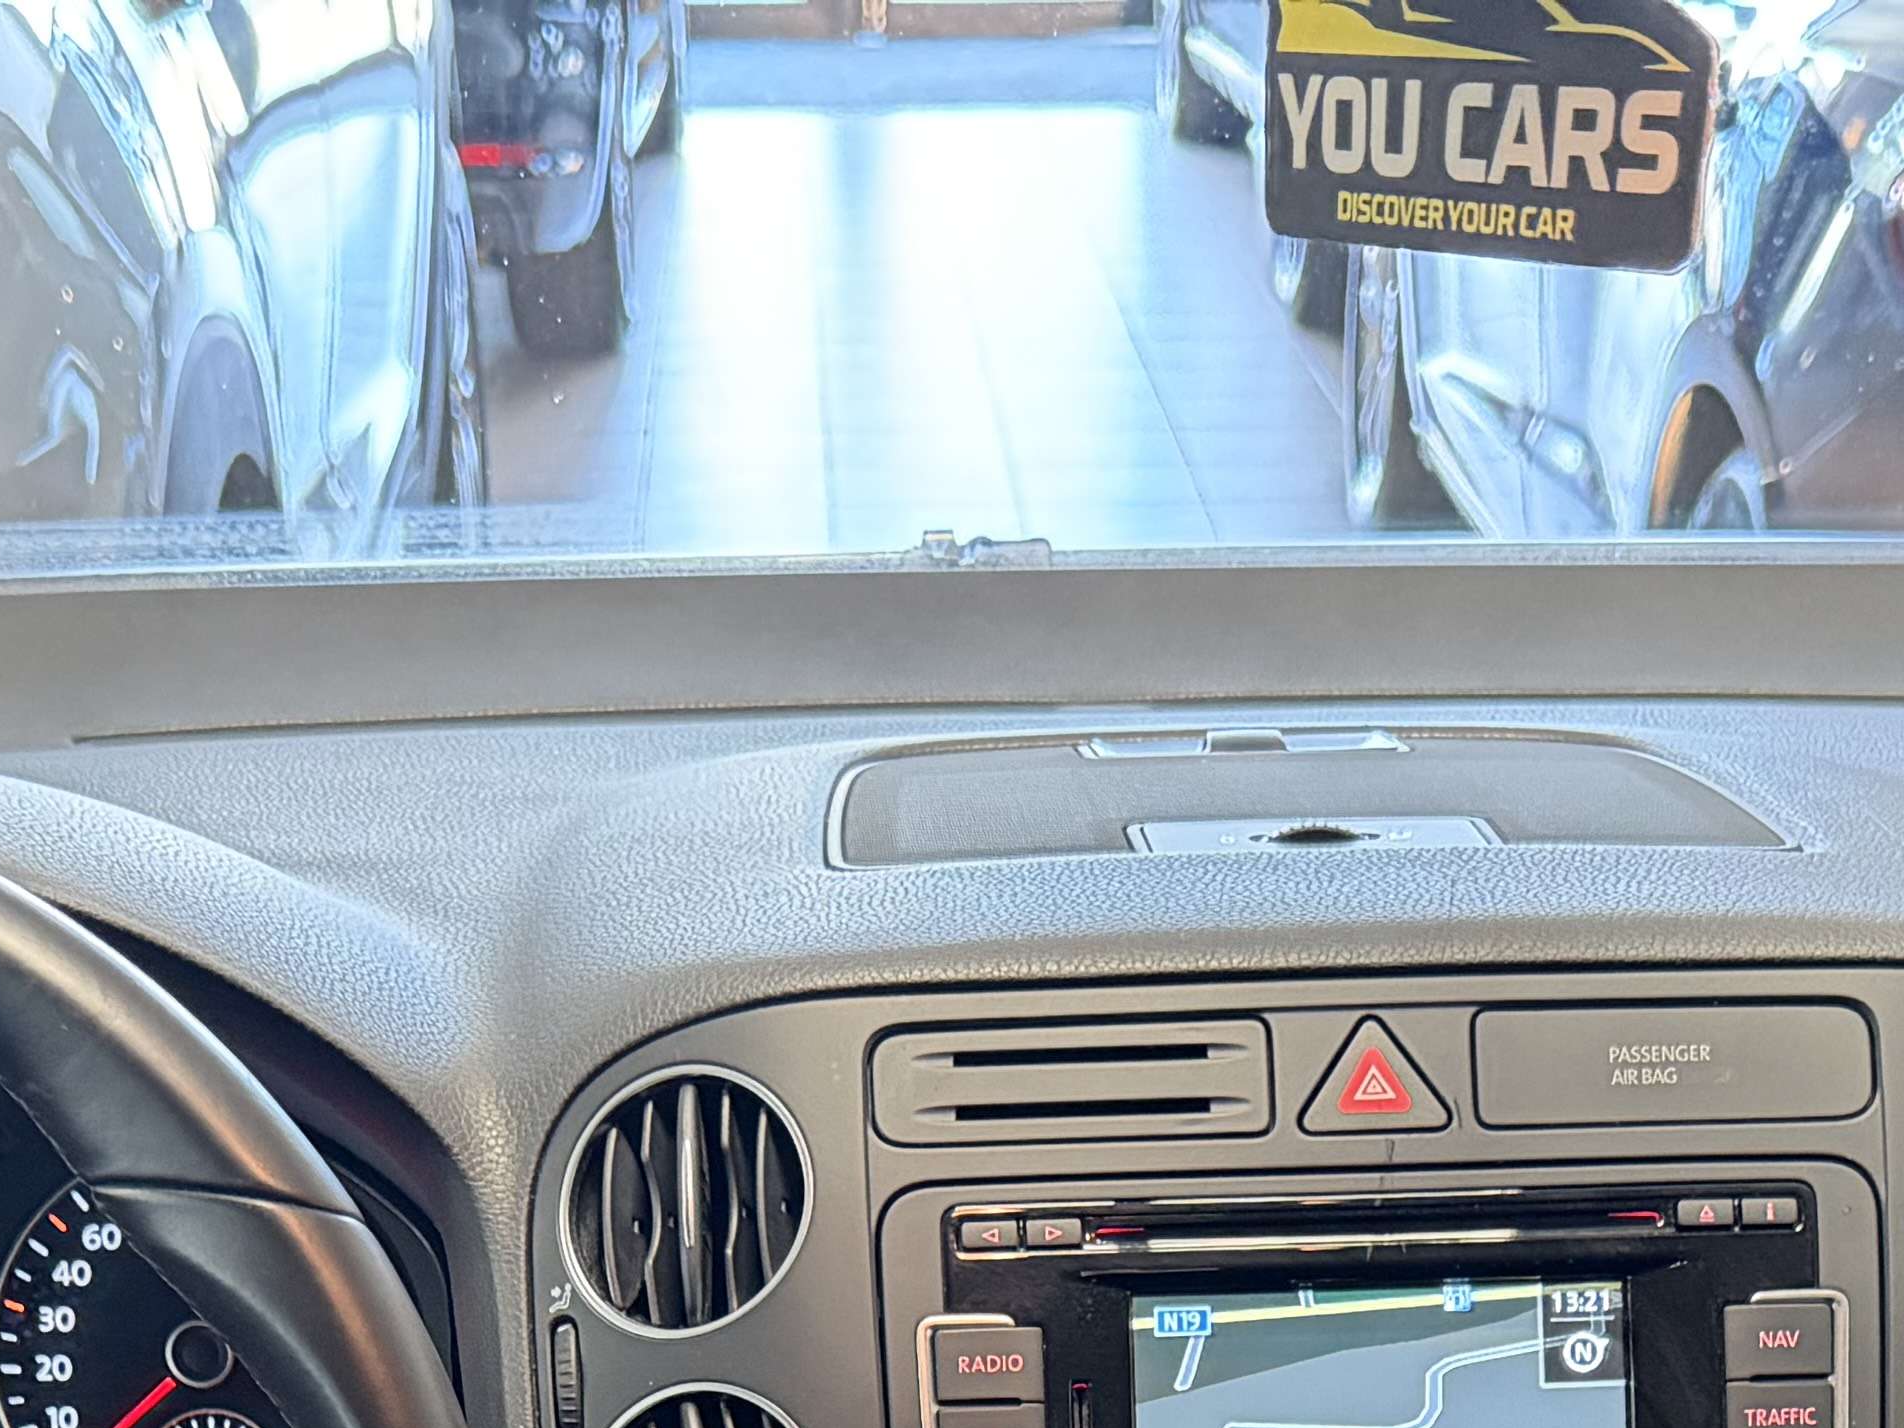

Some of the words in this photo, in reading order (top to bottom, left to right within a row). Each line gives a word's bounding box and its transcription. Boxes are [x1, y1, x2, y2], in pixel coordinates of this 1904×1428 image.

[1277, 73, 1423, 178] YOU
[1443, 82, 1683, 195] CARS
[1336, 190, 1445, 227] DISCOVER
[1447, 199, 1515, 238] YOUR
[1518, 205, 1576, 242] CAR
[1608, 1044, 1711, 1063] PASSENGER
[1610, 1067, 1639, 1086] AIR
[1641, 1066, 1678, 1085] BAG
[80, 1223, 122, 1251] 60
[51, 1259, 92, 1288] 40
[1550, 1287, 1610, 1314] 13:21
[37, 1305, 76, 1333] 30
[1162, 1310, 1202, 1332] N19
[1758, 1329, 1800, 1349] NAV
[34, 1353, 73, 1382] 20
[957, 1353, 1024, 1374] RADIO
[1743, 1406, 1818, 1427] TRAFFIC
